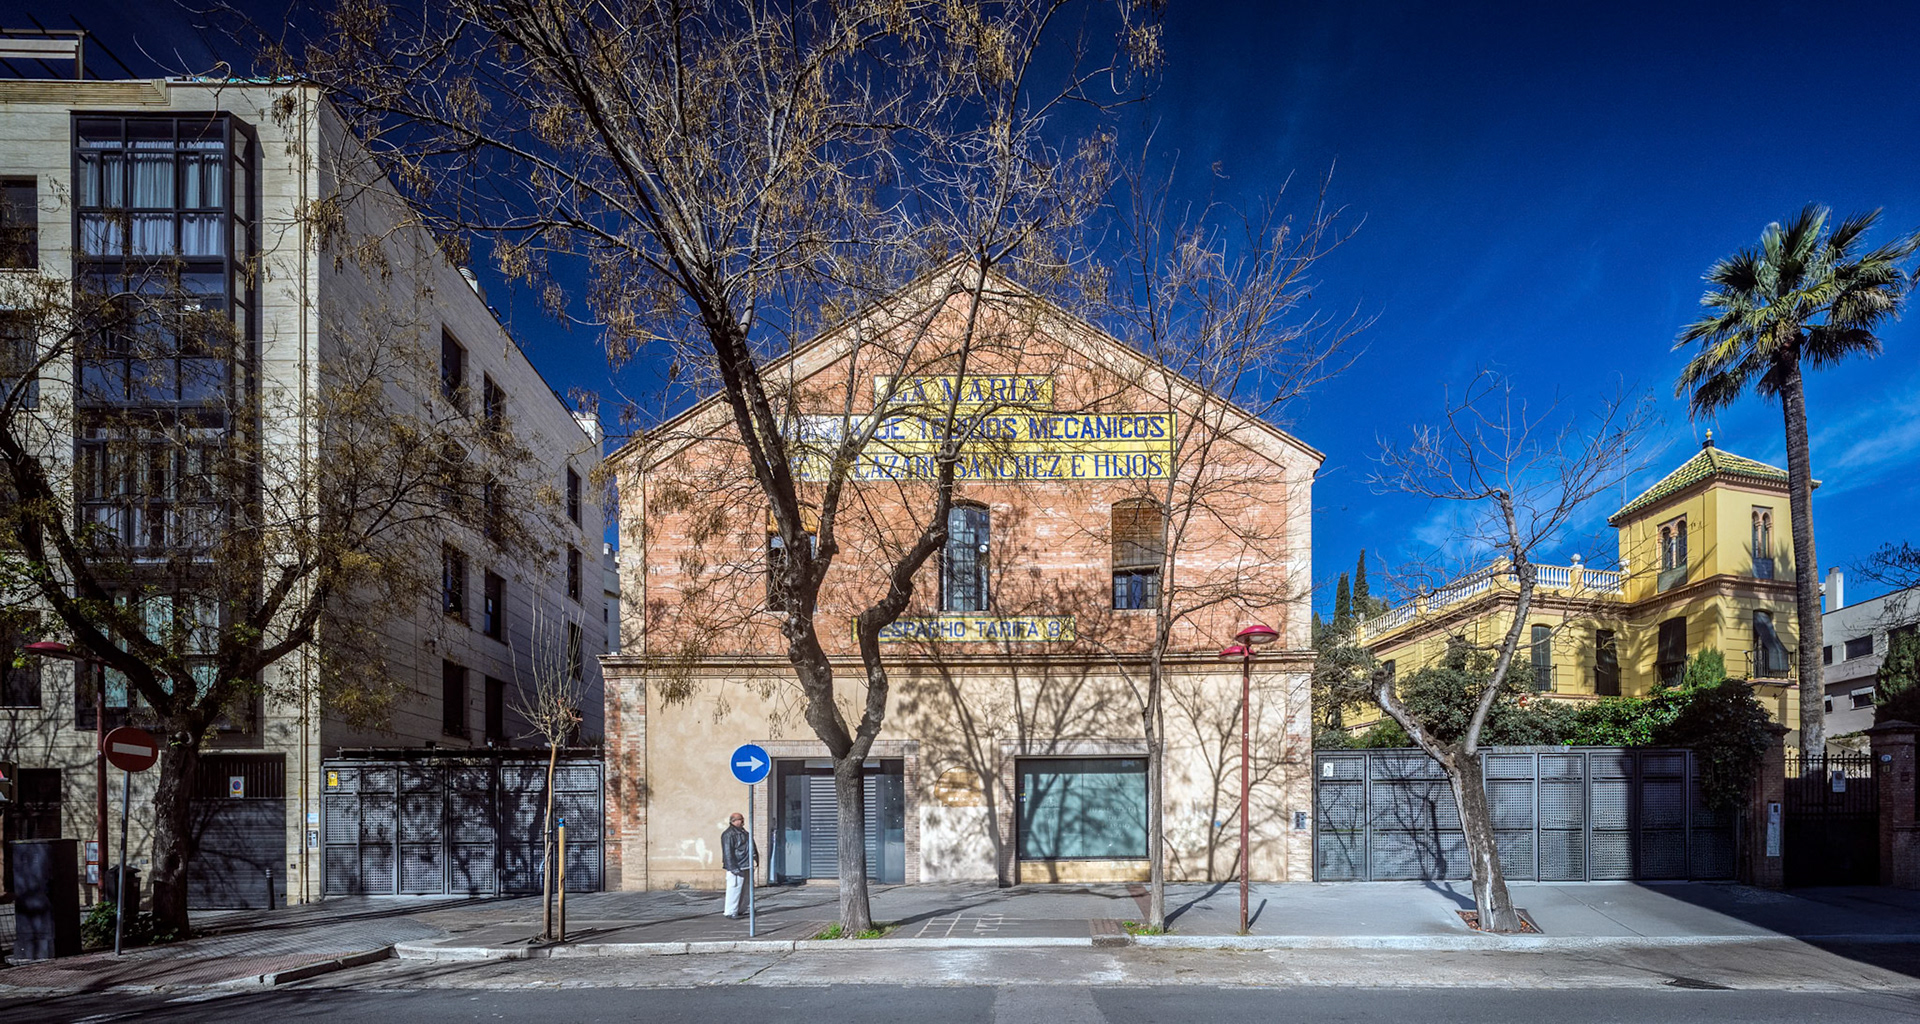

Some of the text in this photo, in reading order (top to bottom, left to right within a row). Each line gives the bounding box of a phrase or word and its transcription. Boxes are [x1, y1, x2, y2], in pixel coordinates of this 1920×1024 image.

[889, 378, 1038, 402] LA MARIA
[1029, 416, 1165, 439] MECANICOS
[954, 454, 1062, 478] SANCHEZ
[1071, 455, 1085, 477] E
[1094, 454, 1163, 477] HIJOS
[879, 621, 966, 638] ESPACHO
[975, 621, 1039, 638] TARIFA
